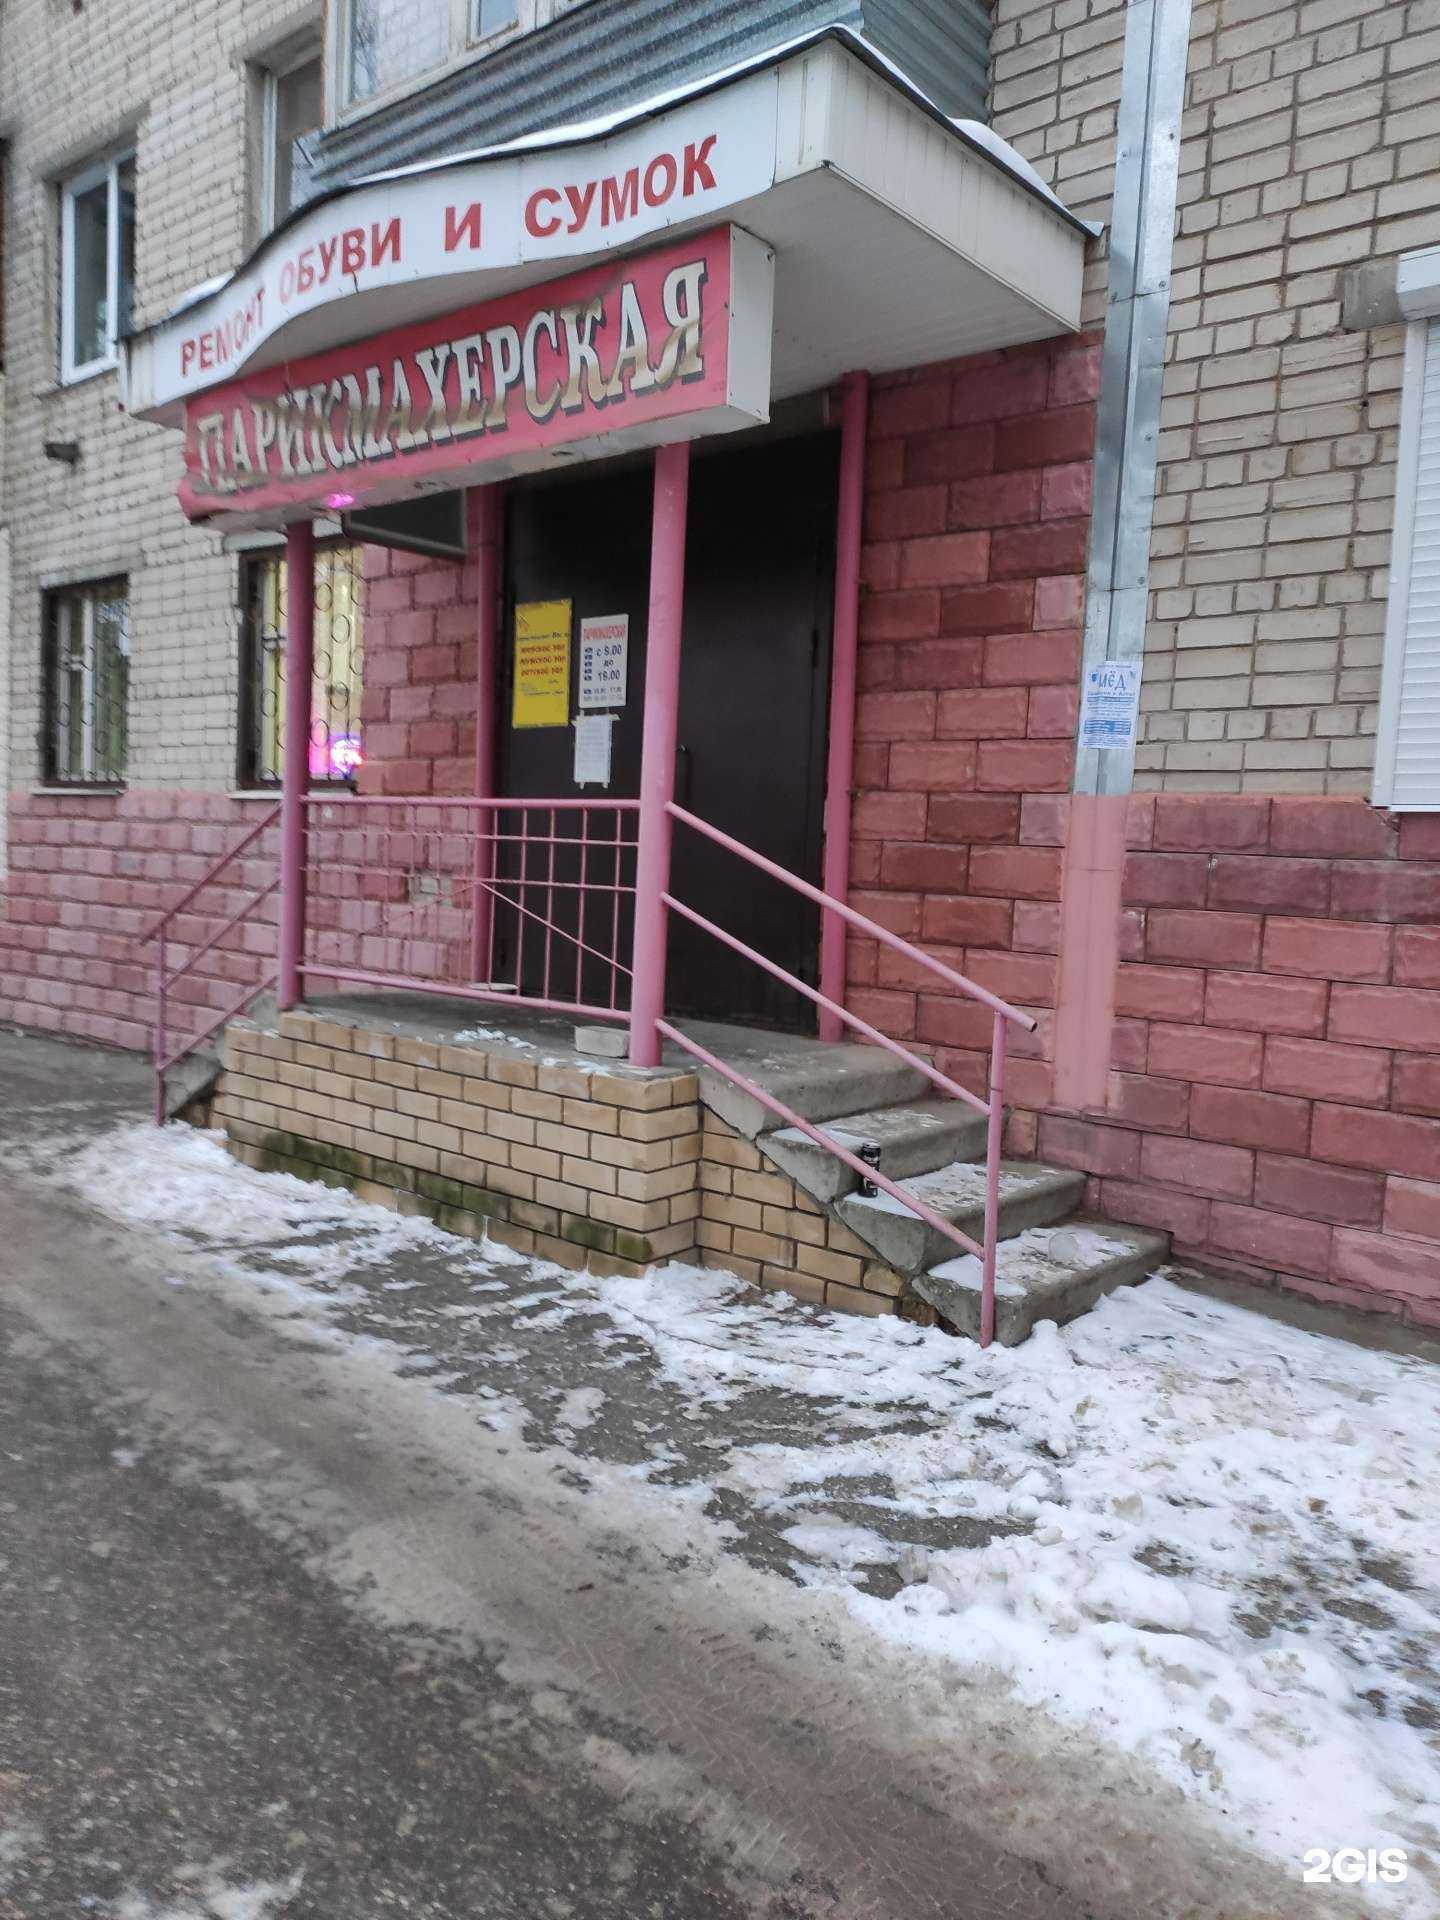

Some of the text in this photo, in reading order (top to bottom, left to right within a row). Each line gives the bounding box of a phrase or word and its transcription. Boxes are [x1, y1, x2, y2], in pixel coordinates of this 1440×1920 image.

[181, 134, 717, 378] РЕМОНТ ОБУВИ И СУМОК
[197, 261, 709, 493] ПАРИКМАХЕРСКАЯ
